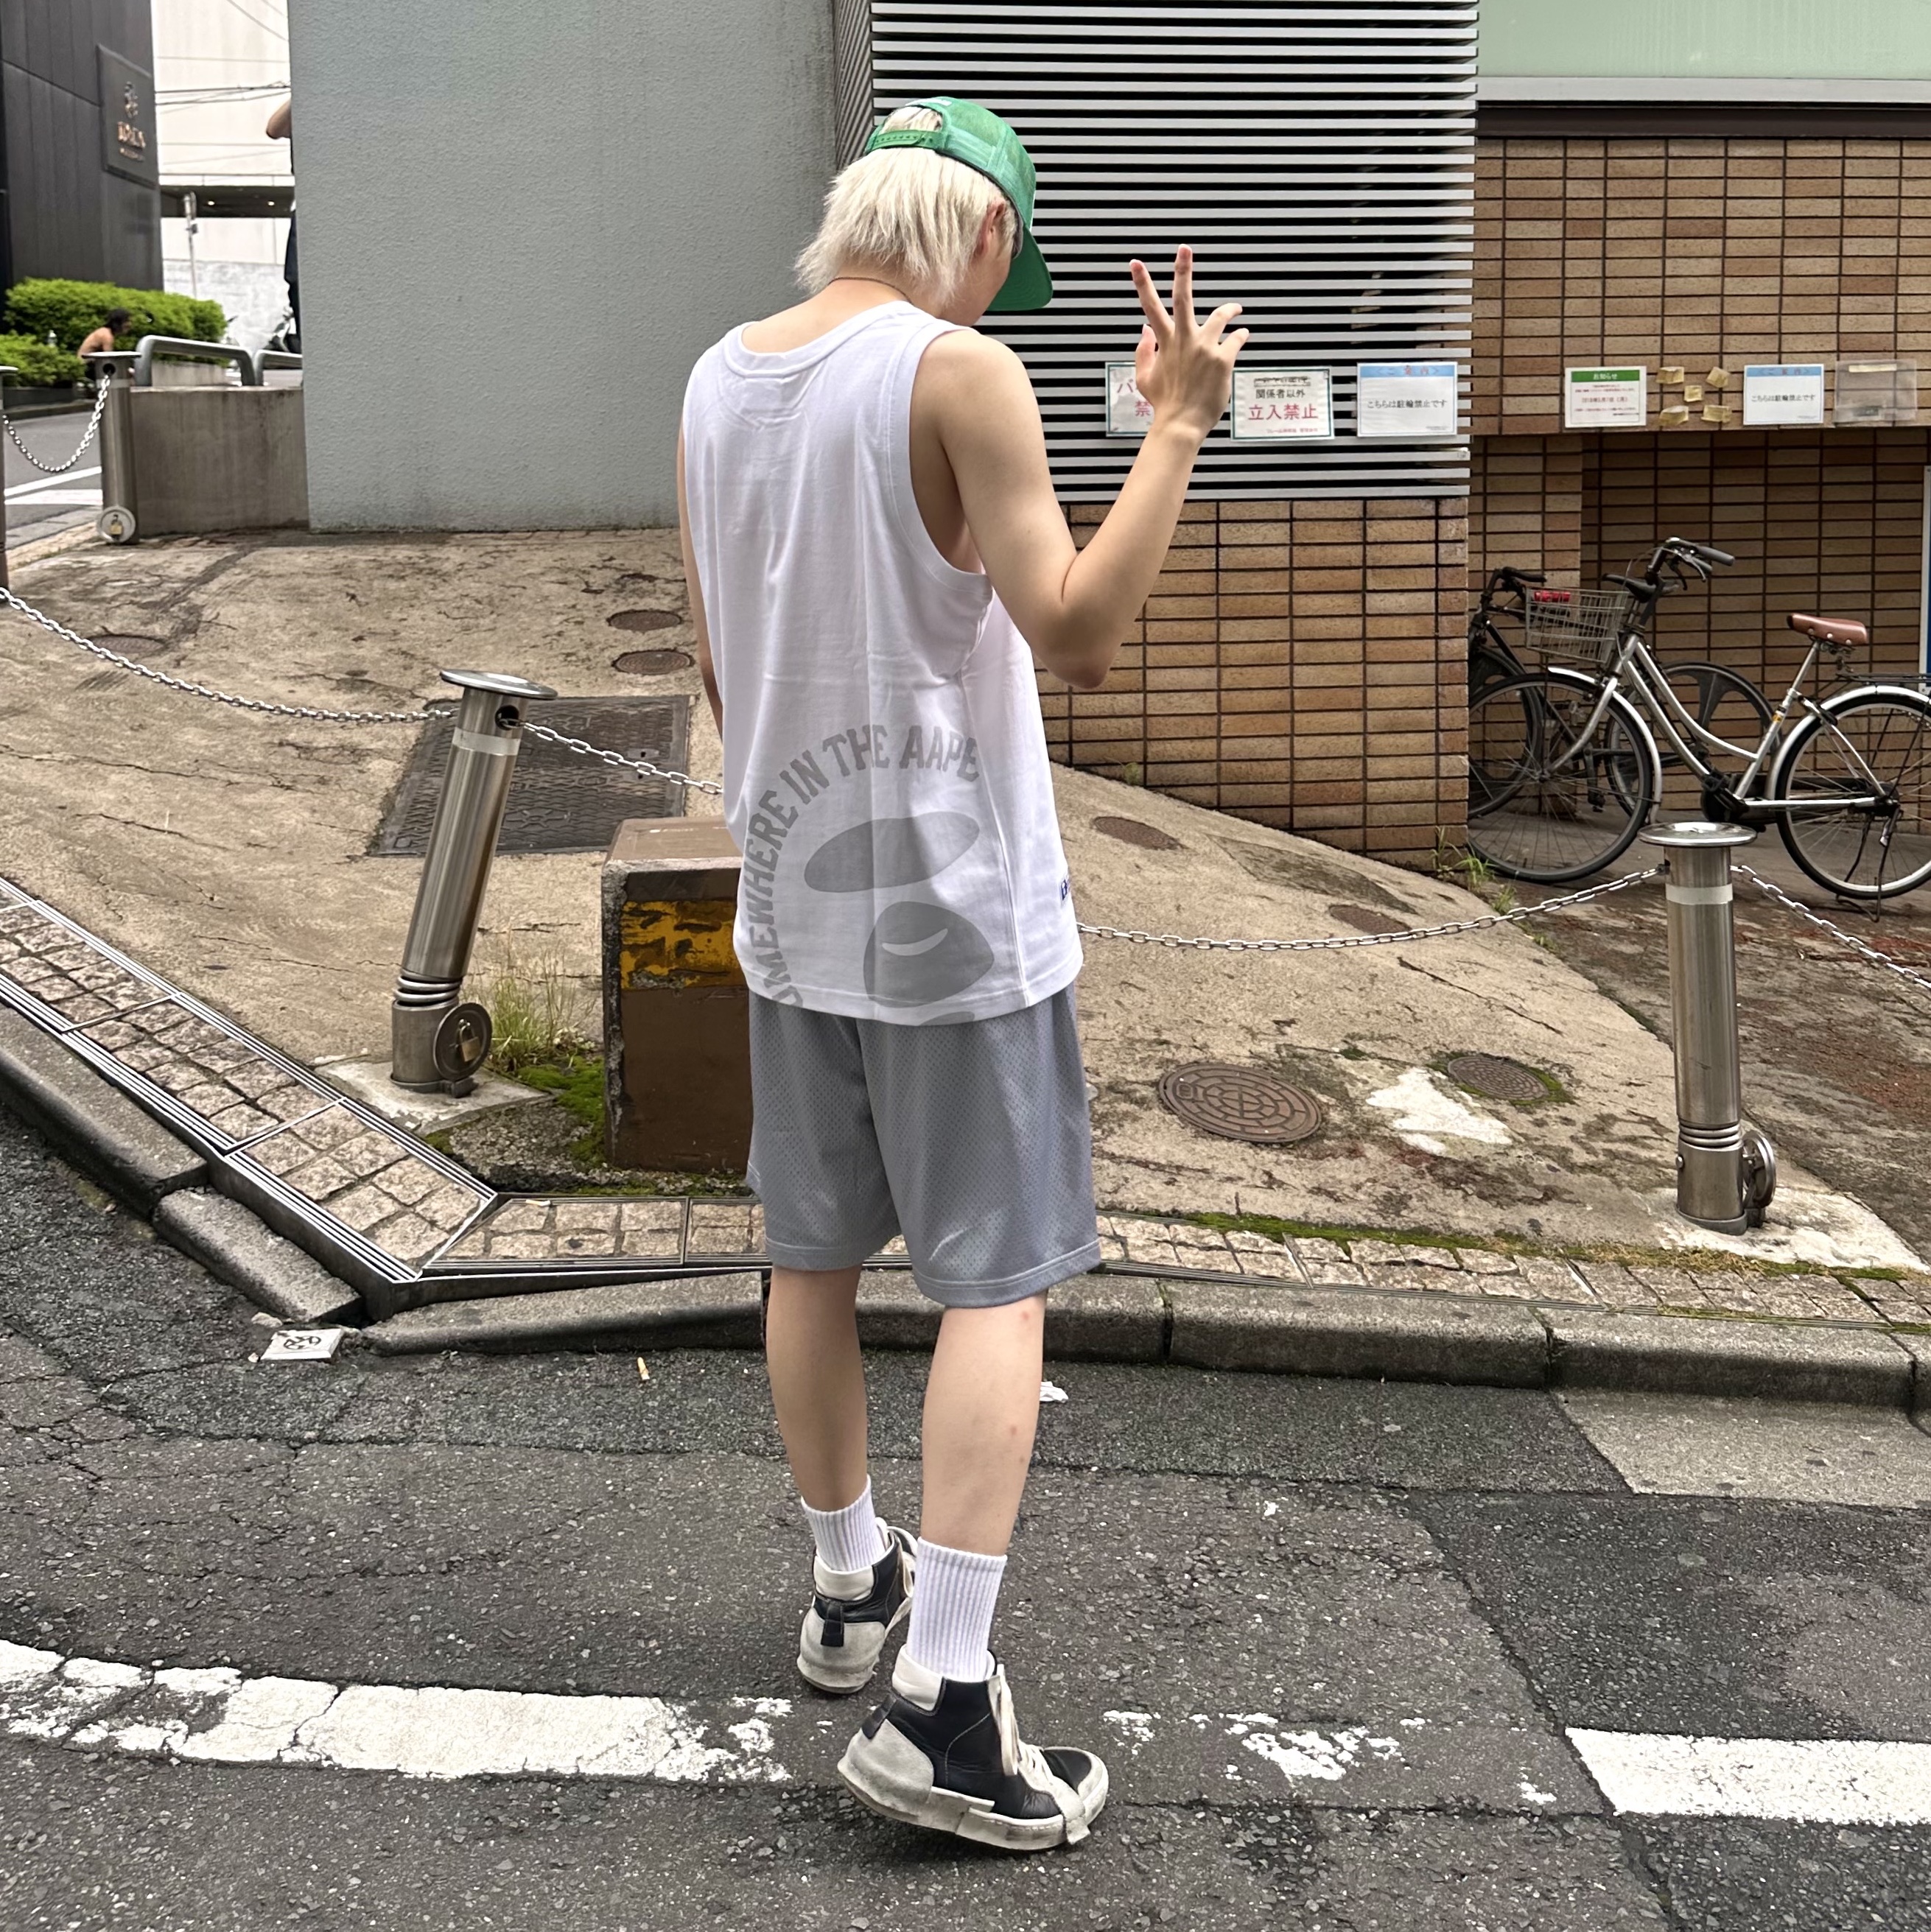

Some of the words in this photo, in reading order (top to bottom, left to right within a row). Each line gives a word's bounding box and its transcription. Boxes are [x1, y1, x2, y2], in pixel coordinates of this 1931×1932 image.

[1255, 389, 1306, 398] 関係者以外
[1367, 399, 1448, 409] こちらは駐輪禁止です
[1248, 403, 1319, 421] 立入禁止
[779, 749, 830, 805] IN
[821, 724, 891, 777] THE
[899, 725, 980, 782] AAPE
